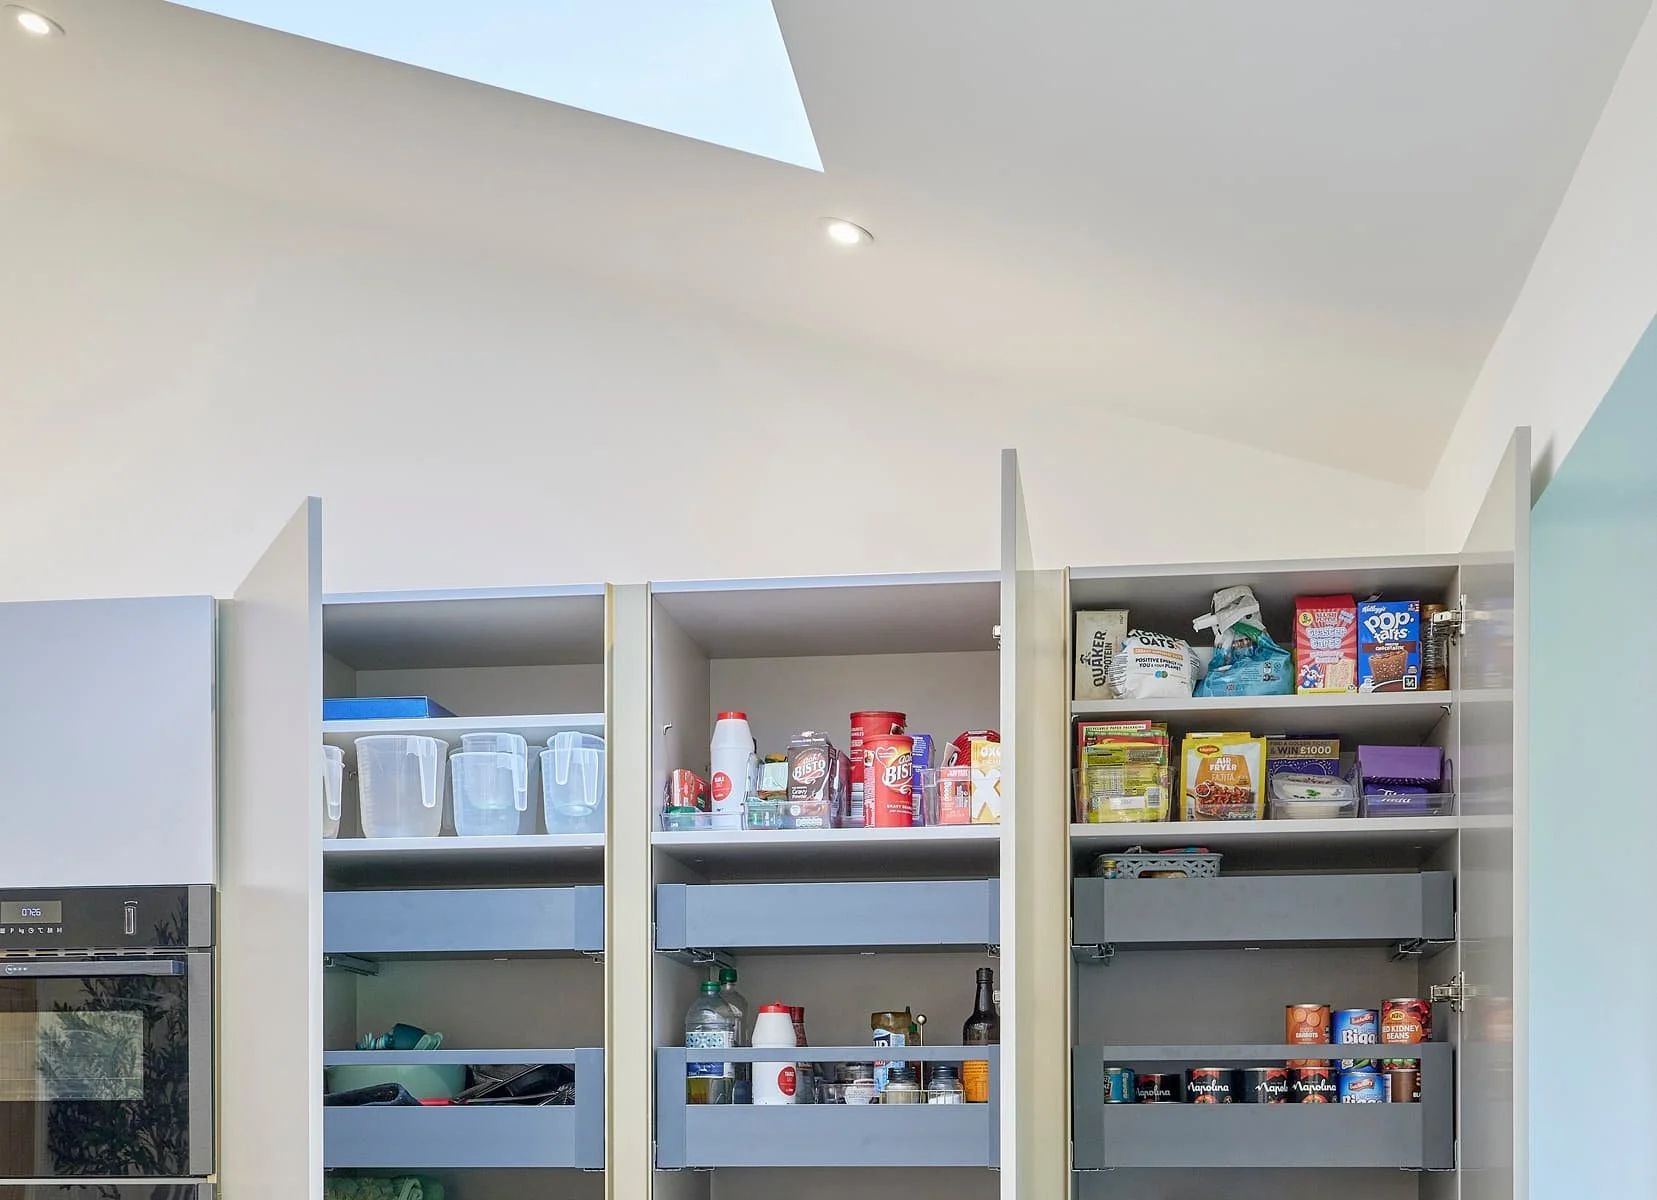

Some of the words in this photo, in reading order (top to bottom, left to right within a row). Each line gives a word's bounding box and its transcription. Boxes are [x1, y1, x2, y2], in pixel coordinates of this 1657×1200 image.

[1092, 630, 1107, 687] QUAKER
[1278, 746, 1298, 754] WIN
[1300, 746, 1332, 754] £1000
[793, 760, 826, 778] BISTO
[1209, 763, 1237, 771] FRYER
[1187, 1079, 1230, 1094] Napolina
[1292, 1078, 1337, 1094] Napolina
